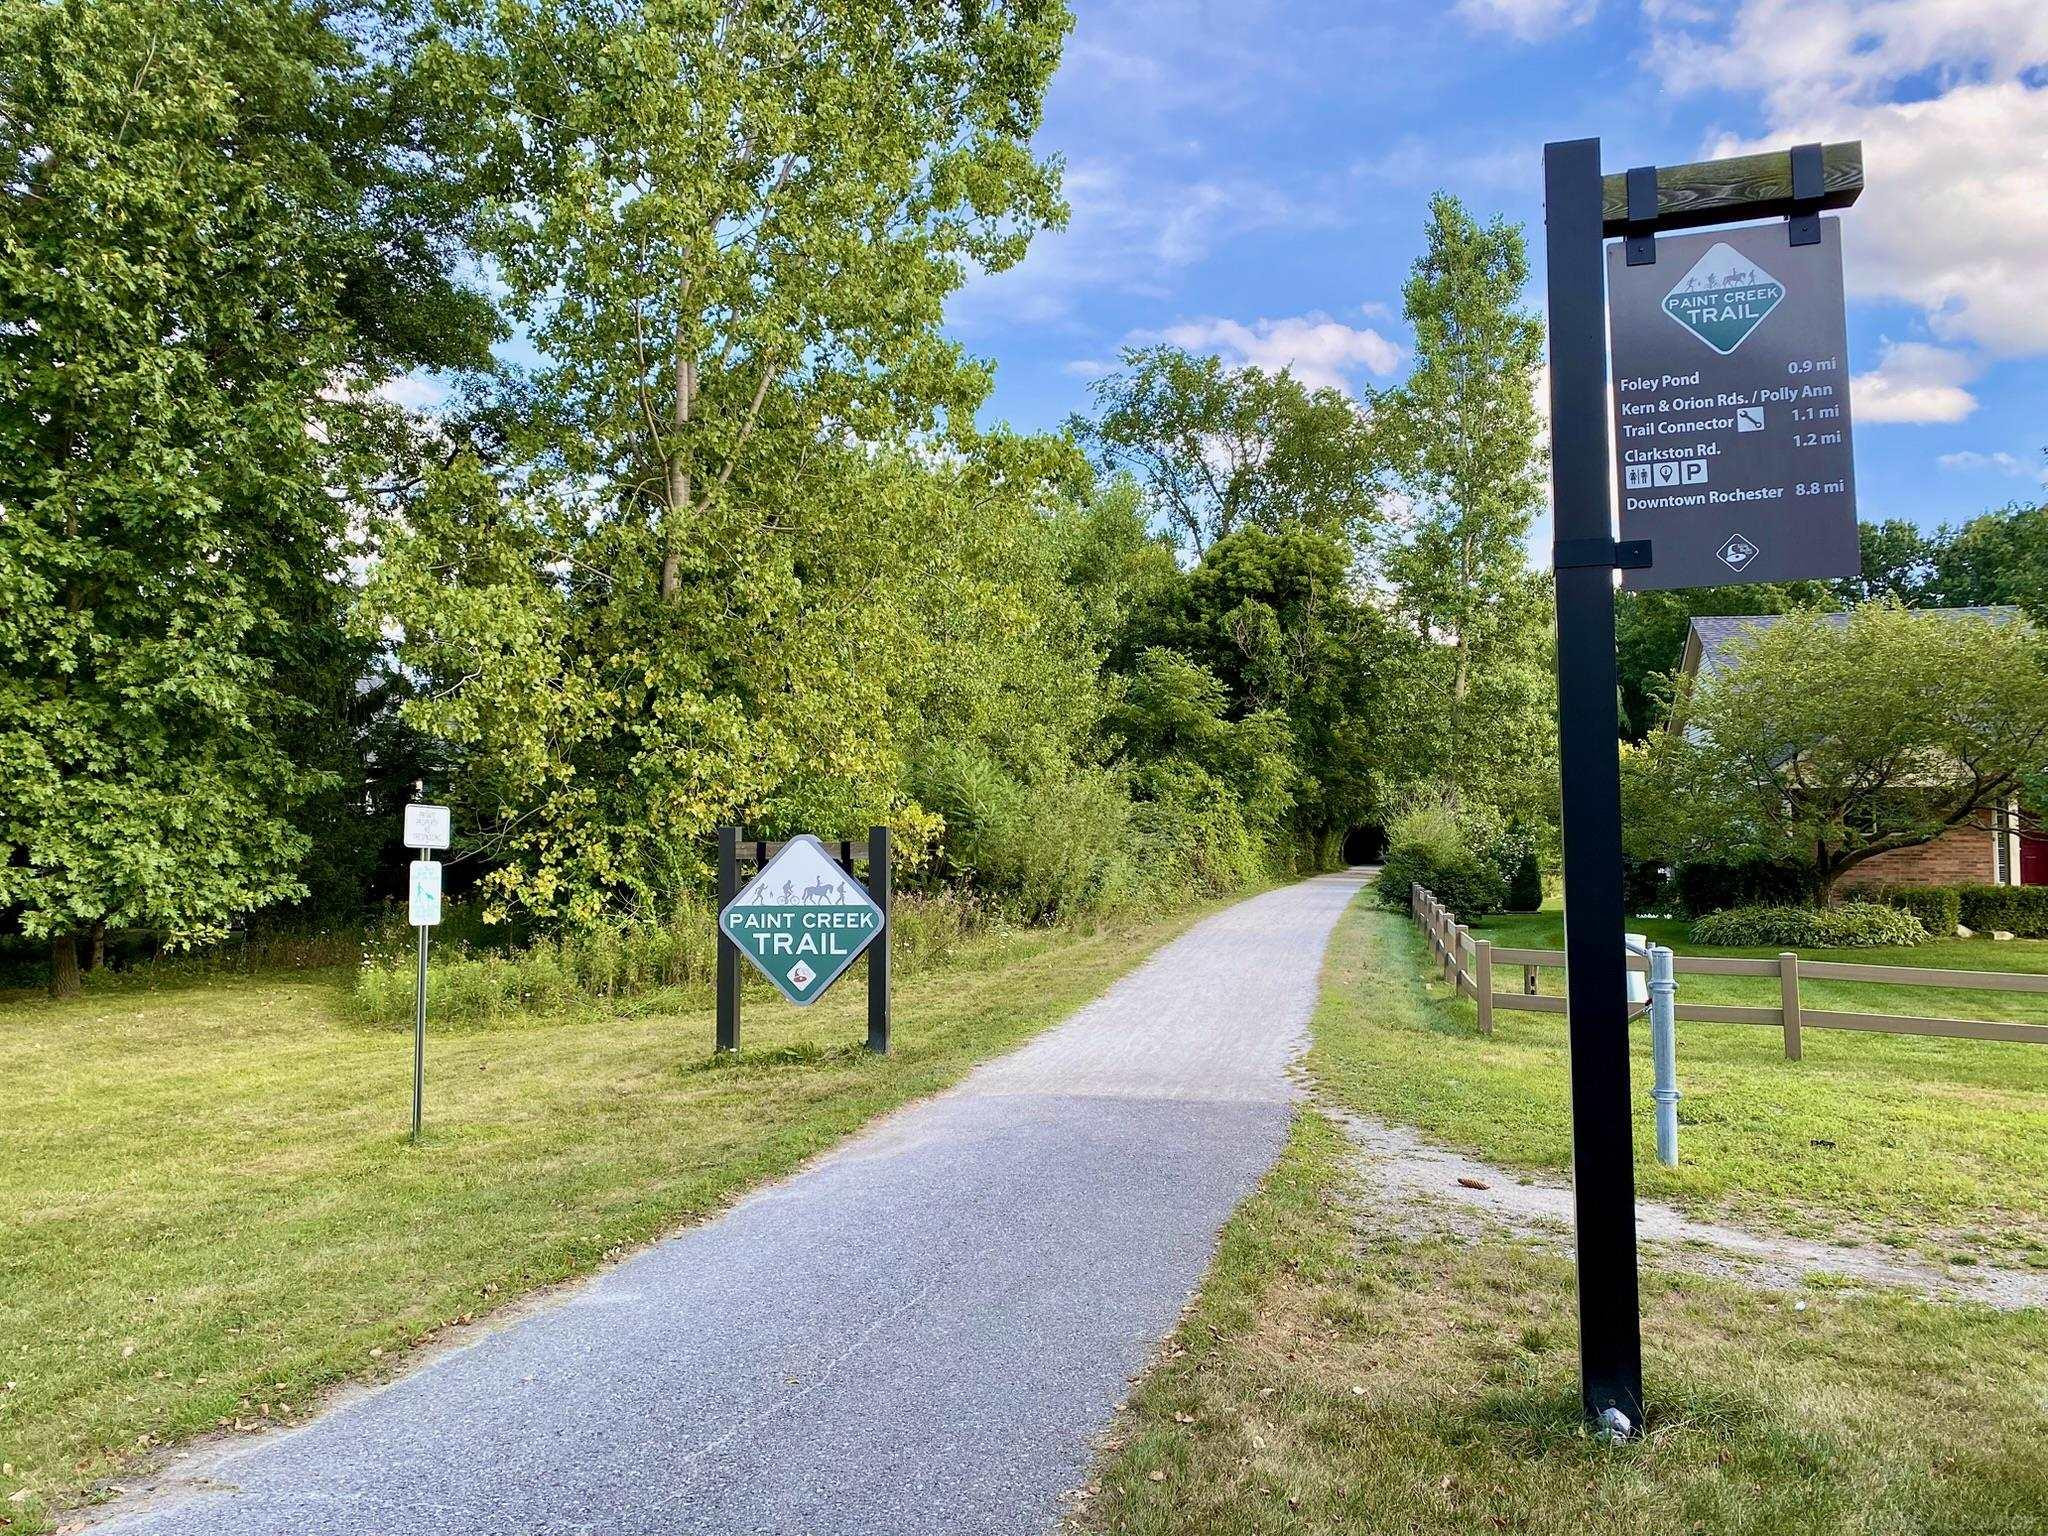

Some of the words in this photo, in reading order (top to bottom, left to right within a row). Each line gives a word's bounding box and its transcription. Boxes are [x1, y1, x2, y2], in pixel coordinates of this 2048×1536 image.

[1669, 294, 1719, 310] PAINT
[1724, 287, 1779, 303] CREEK
[1687, 303, 1759, 324] TRAIL
[1788, 360, 1813, 374] 0.9
[1816, 357, 1837, 371] mi
[1620, 377, 1659, 392] Foley
[1662, 371, 1700, 388] Pond
[1621, 403, 1655, 416] Kern
[1658, 399, 1670, 412] &
[1672, 396, 1714, 411] Orion
[1717, 392, 1749, 406] Rds.
[1752, 390, 1758, 404] /
[1760, 386, 1798, 402] Polly
[1801, 385, 1833, 398] Ann
[1792, 407, 1815, 421] 1.1
[1820, 404, 1840, 418] mi
[1623, 422, 1655, 437] Trail
[1658, 418, 1734, 434] Connector
[1793, 433, 1818, 447] 1.2
[1821, 430, 1841, 445] mi
[1624, 447, 1694, 462] Clarkston
[1697, 442, 1722, 456] Rd.
[1687, 463, 1702, 481] P
[1795, 482, 1820, 496] 8.8
[1824, 480, 1845, 493] mi
[1626, 494, 1706, 510] Downtown
[1709, 487, 1784, 503] Rochester
[729, 913, 795, 929] PAINT
[802, 912, 874, 929] CREEK
[752, 932, 848, 955] TRAIL
